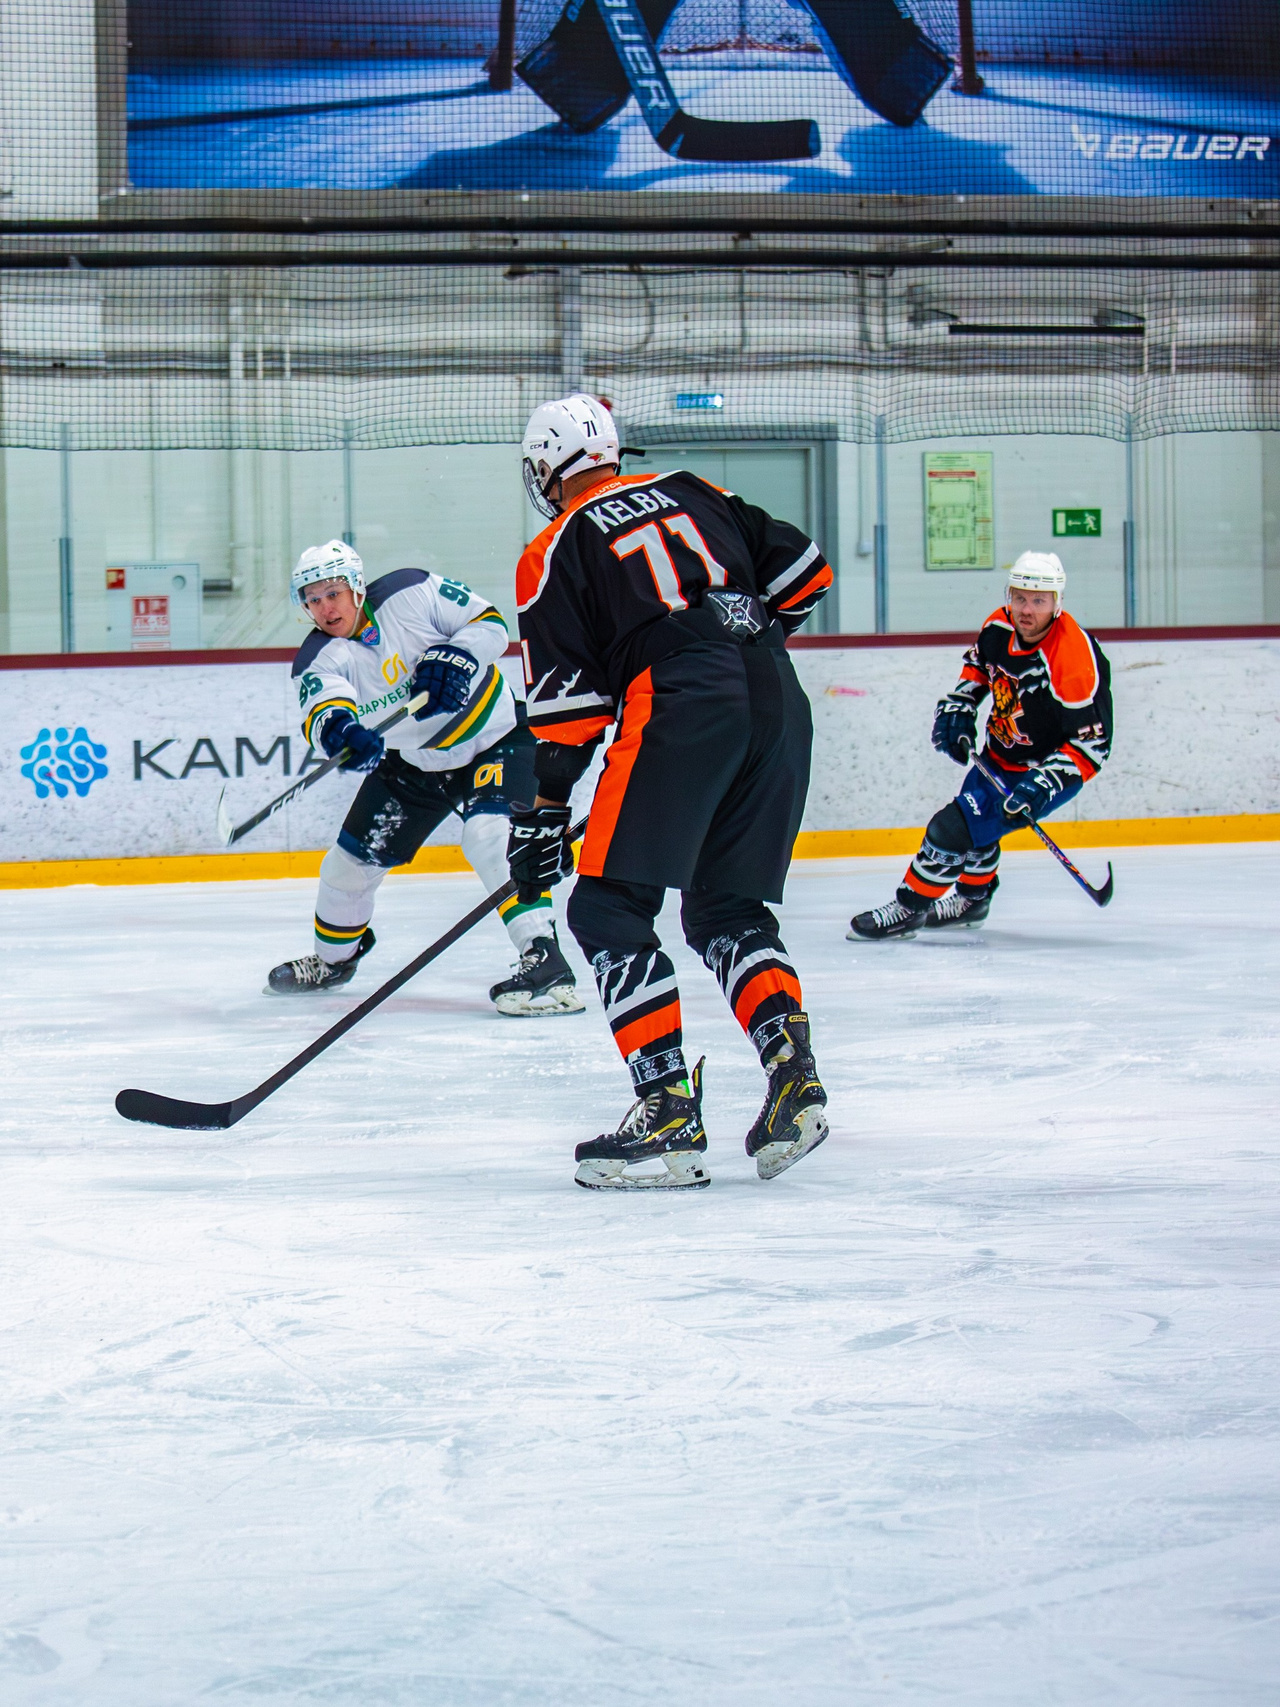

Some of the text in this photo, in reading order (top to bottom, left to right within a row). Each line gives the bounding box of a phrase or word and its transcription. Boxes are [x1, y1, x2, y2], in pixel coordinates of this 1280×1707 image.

[1105, 134, 1271, 161] BAUER
[583, 420, 598, 438] 71
[585, 488, 680, 534] KELBA
[609, 512, 728, 612] 71
